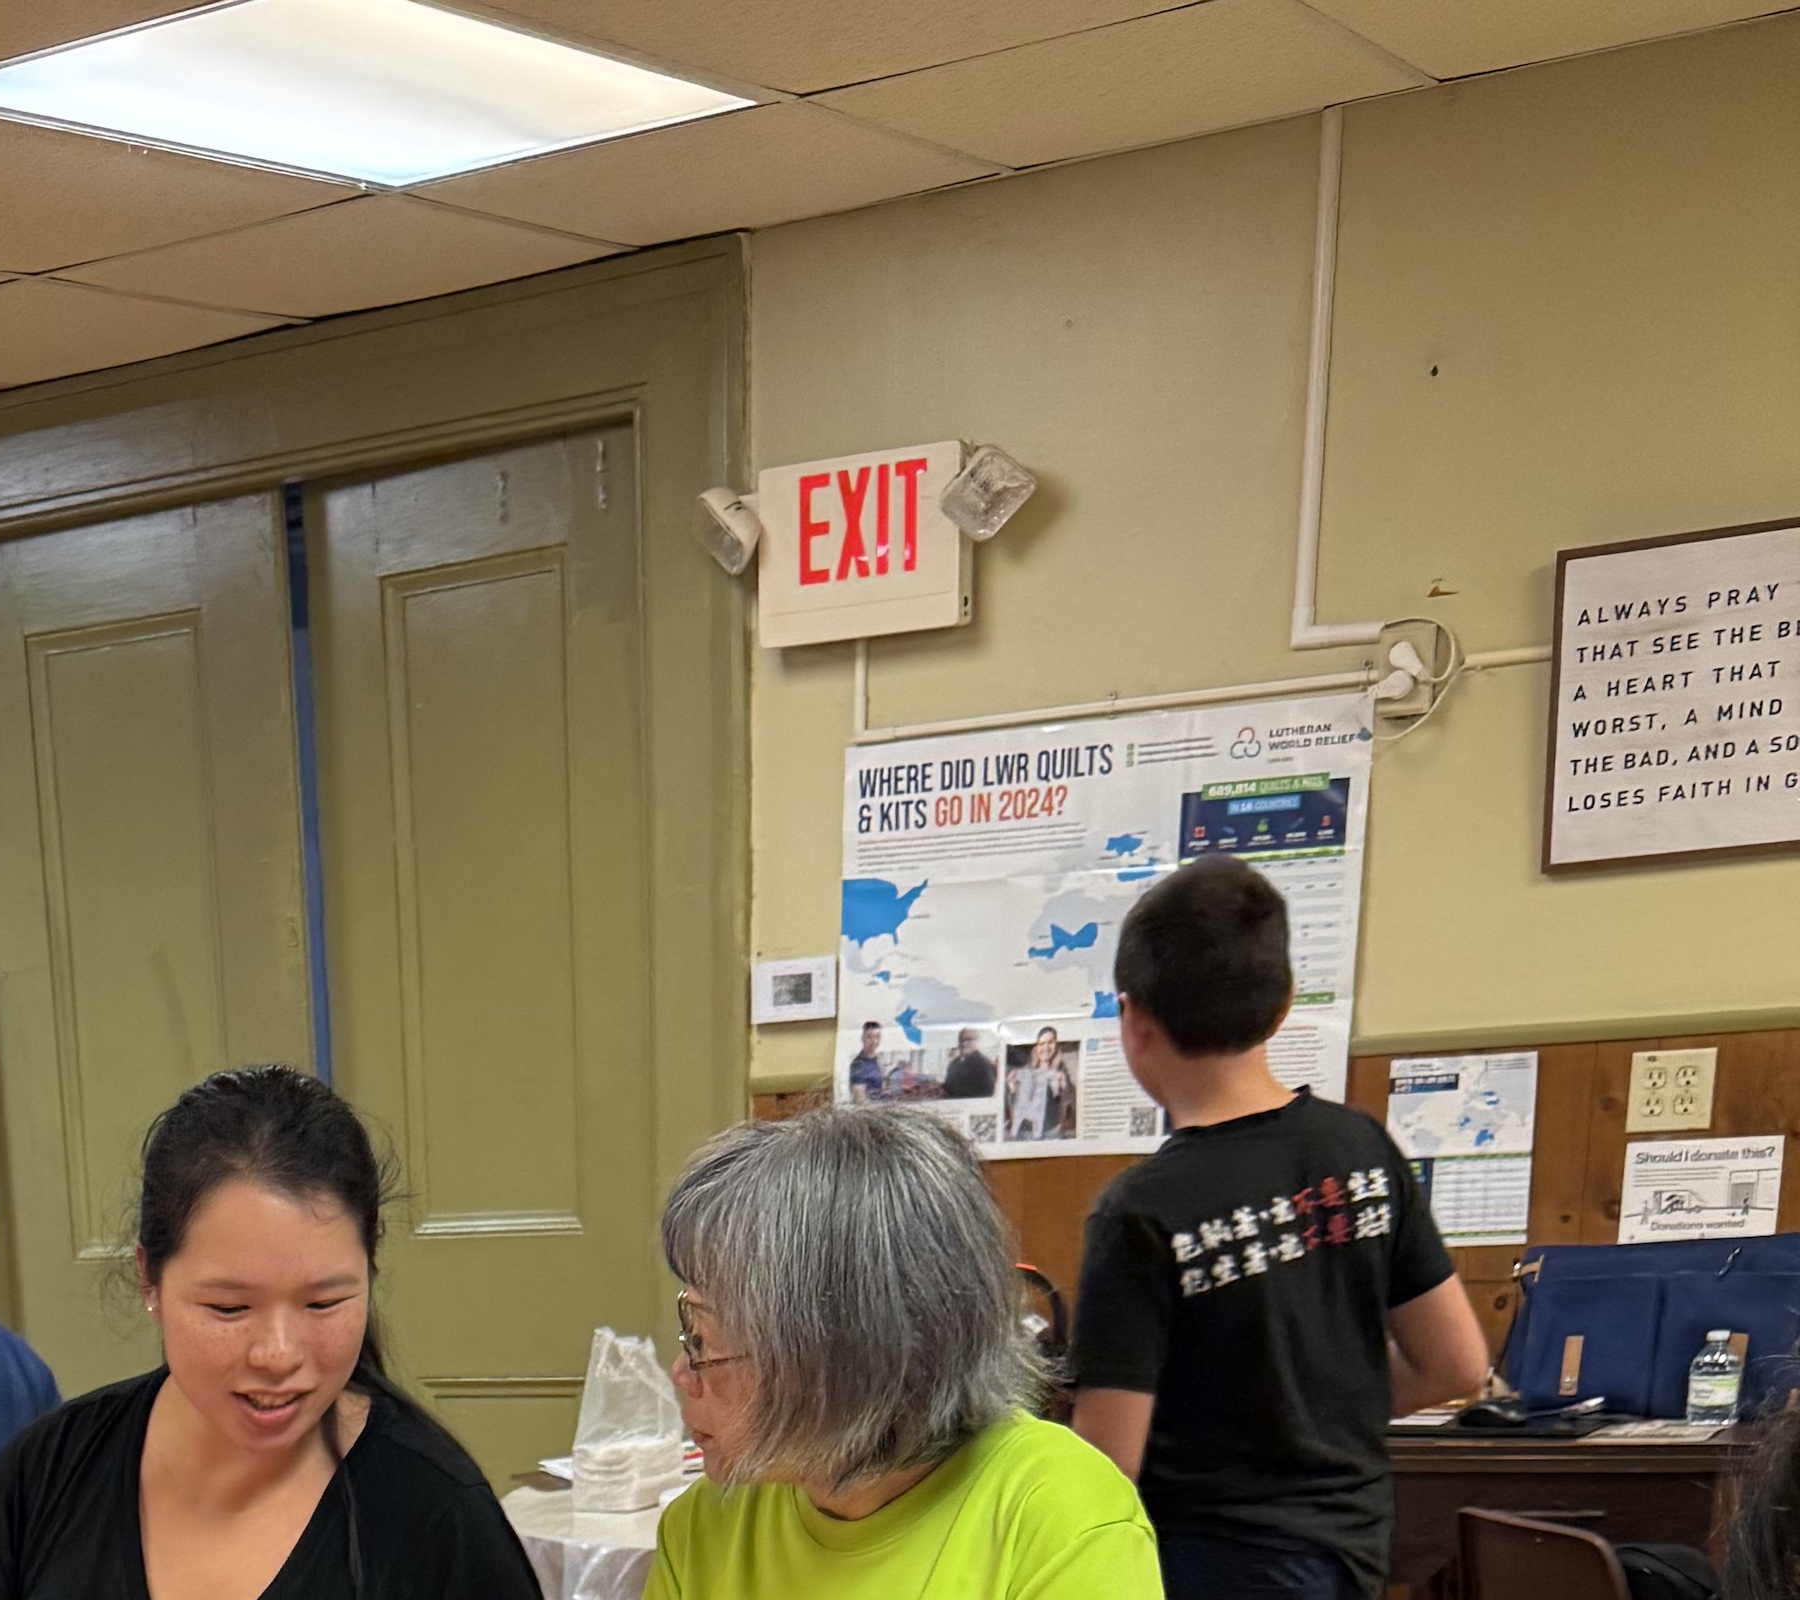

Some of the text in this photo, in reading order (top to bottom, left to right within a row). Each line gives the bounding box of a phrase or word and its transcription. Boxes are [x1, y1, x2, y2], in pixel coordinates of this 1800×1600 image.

[799, 458, 928, 586] EXIT
[1577, 583, 1780, 626] ALWAYS PRAY
[1576, 640, 1639, 663] THAT
[1652, 632, 1700, 654] SEE
[1713, 624, 1763, 646] THE
[1573, 661, 1781, 701] A HEART THAT
[1268, 723, 1332, 738] LUTHERAN
[1572, 698, 1784, 738] WORST, A MIND
[1267, 734, 1356, 752] WORLD RELIEF
[1570, 756, 1615, 776] THE
[1623, 749, 1678, 770] BAD,
[1687, 741, 1736, 762] AND
[1745, 739, 1760, 756] A
[858, 762, 933, 799] WHERE
[939, 758, 974, 791] DID
[982, 752, 1029, 787] LWR
[1036, 743, 1114, 783] QUILTS
[857, 784, 1068, 834] & KITS GO IN 2024?
[1567, 789, 1645, 813] LOSES
[1658, 779, 1732, 802] FAITH
[1745, 775, 1771, 793] IN
[1635, 1149, 1683, 1165] Should
